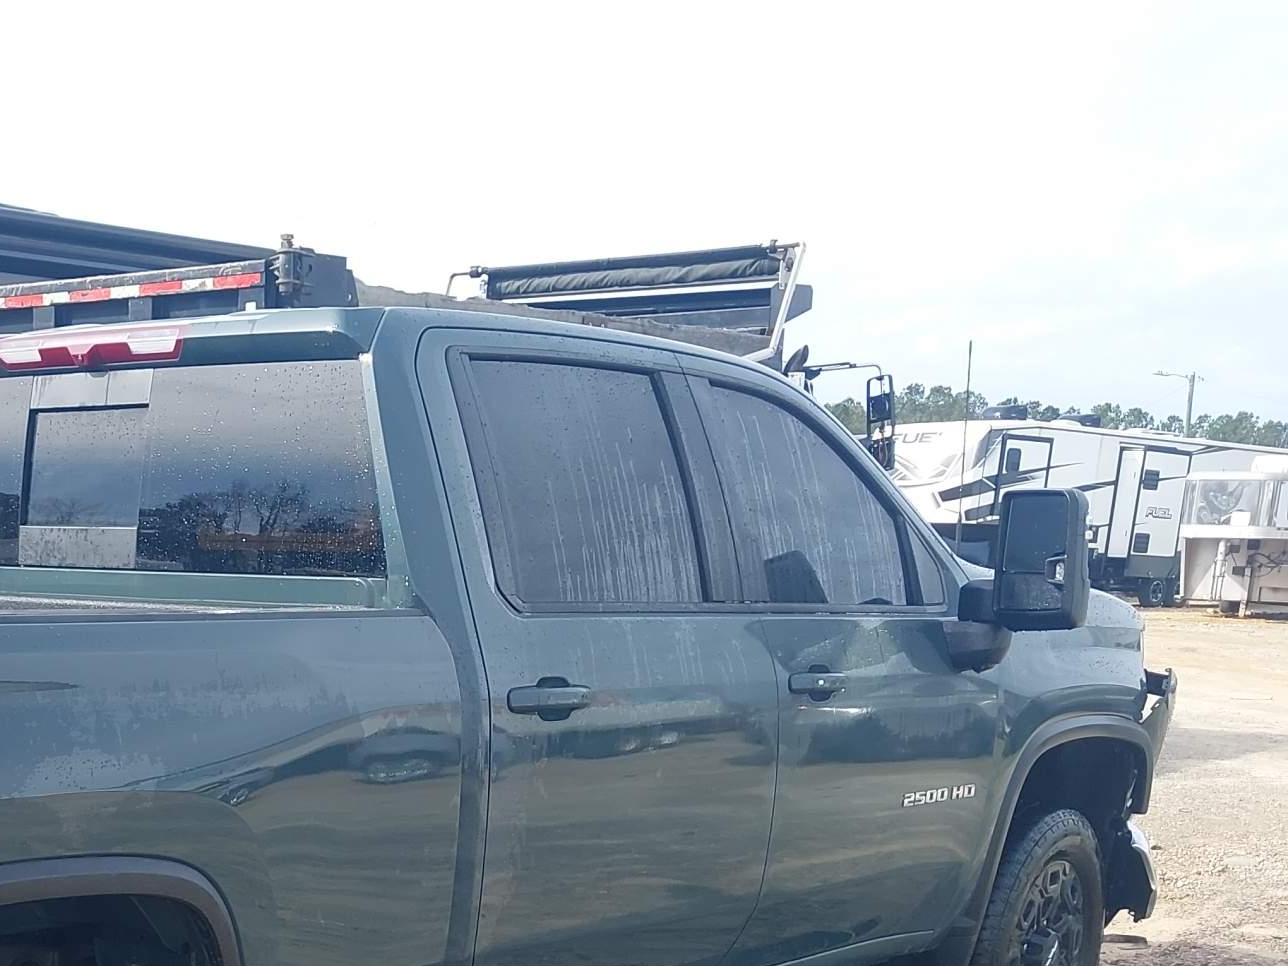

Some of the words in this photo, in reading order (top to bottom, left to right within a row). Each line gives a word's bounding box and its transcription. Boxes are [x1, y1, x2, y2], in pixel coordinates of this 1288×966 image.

[1145, 506, 1172, 519] FUEL
[902, 787, 948, 807] 2500
[951, 783, 976, 800] HD
